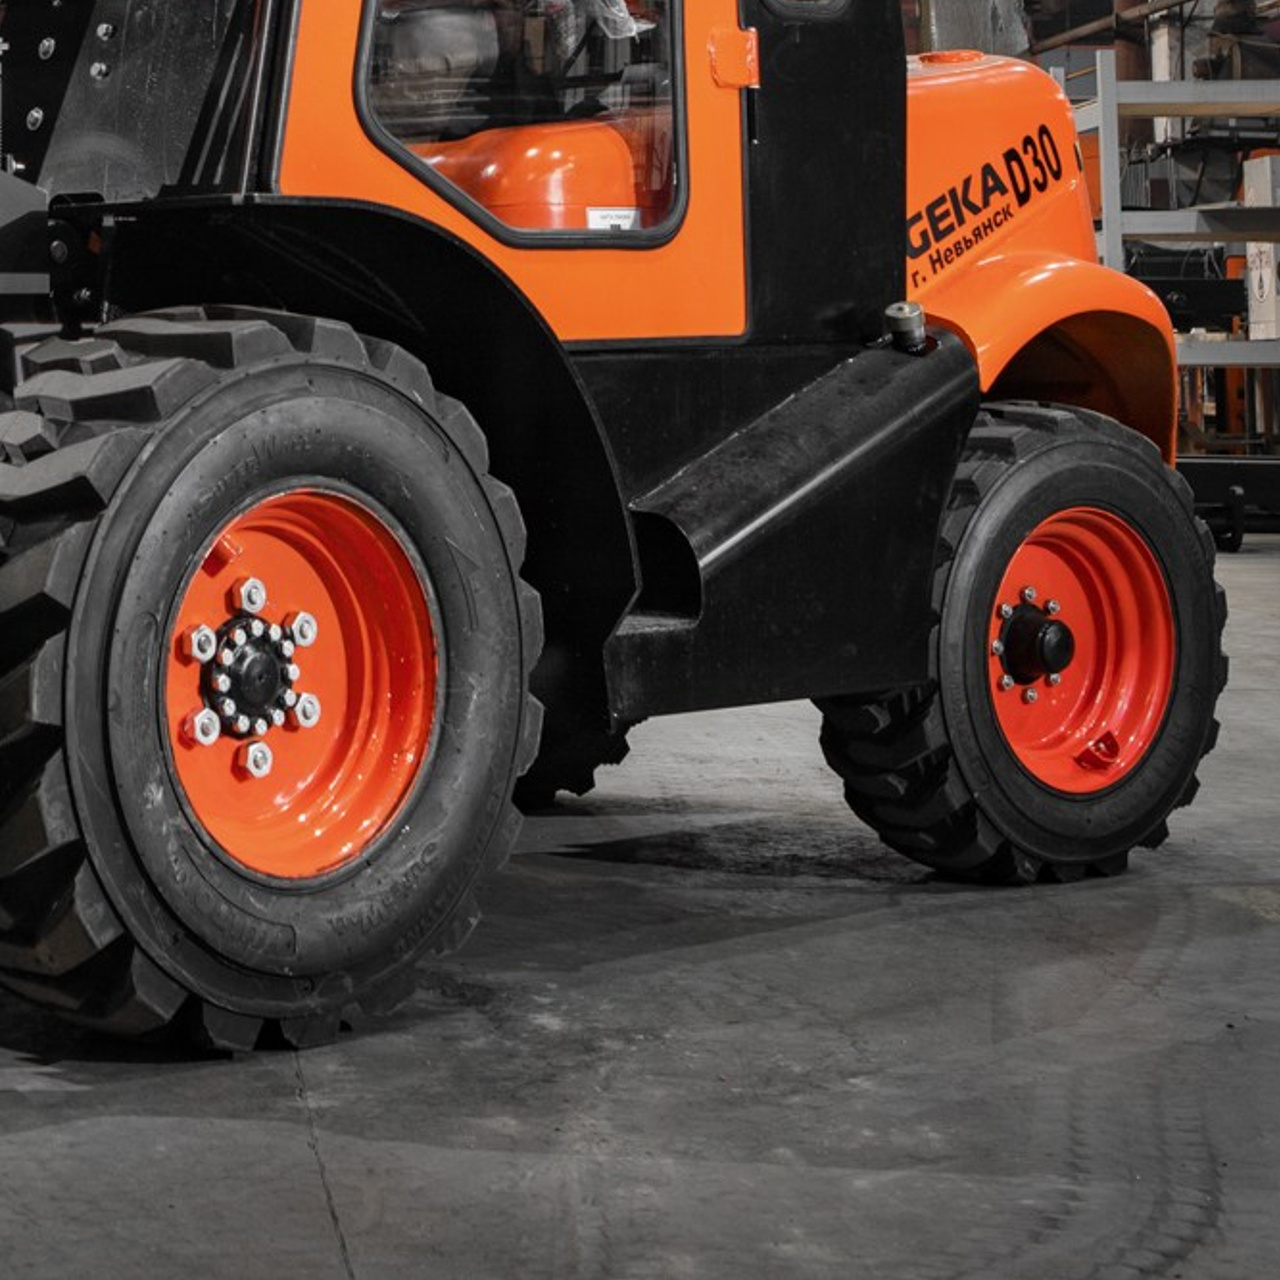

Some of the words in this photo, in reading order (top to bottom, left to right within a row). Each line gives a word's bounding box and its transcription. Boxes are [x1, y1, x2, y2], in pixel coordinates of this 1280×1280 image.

[906, 162, 1009, 260] GEKA
[1002, 124, 1062, 208] D30
[928, 203, 1014, 274] Невьянск
